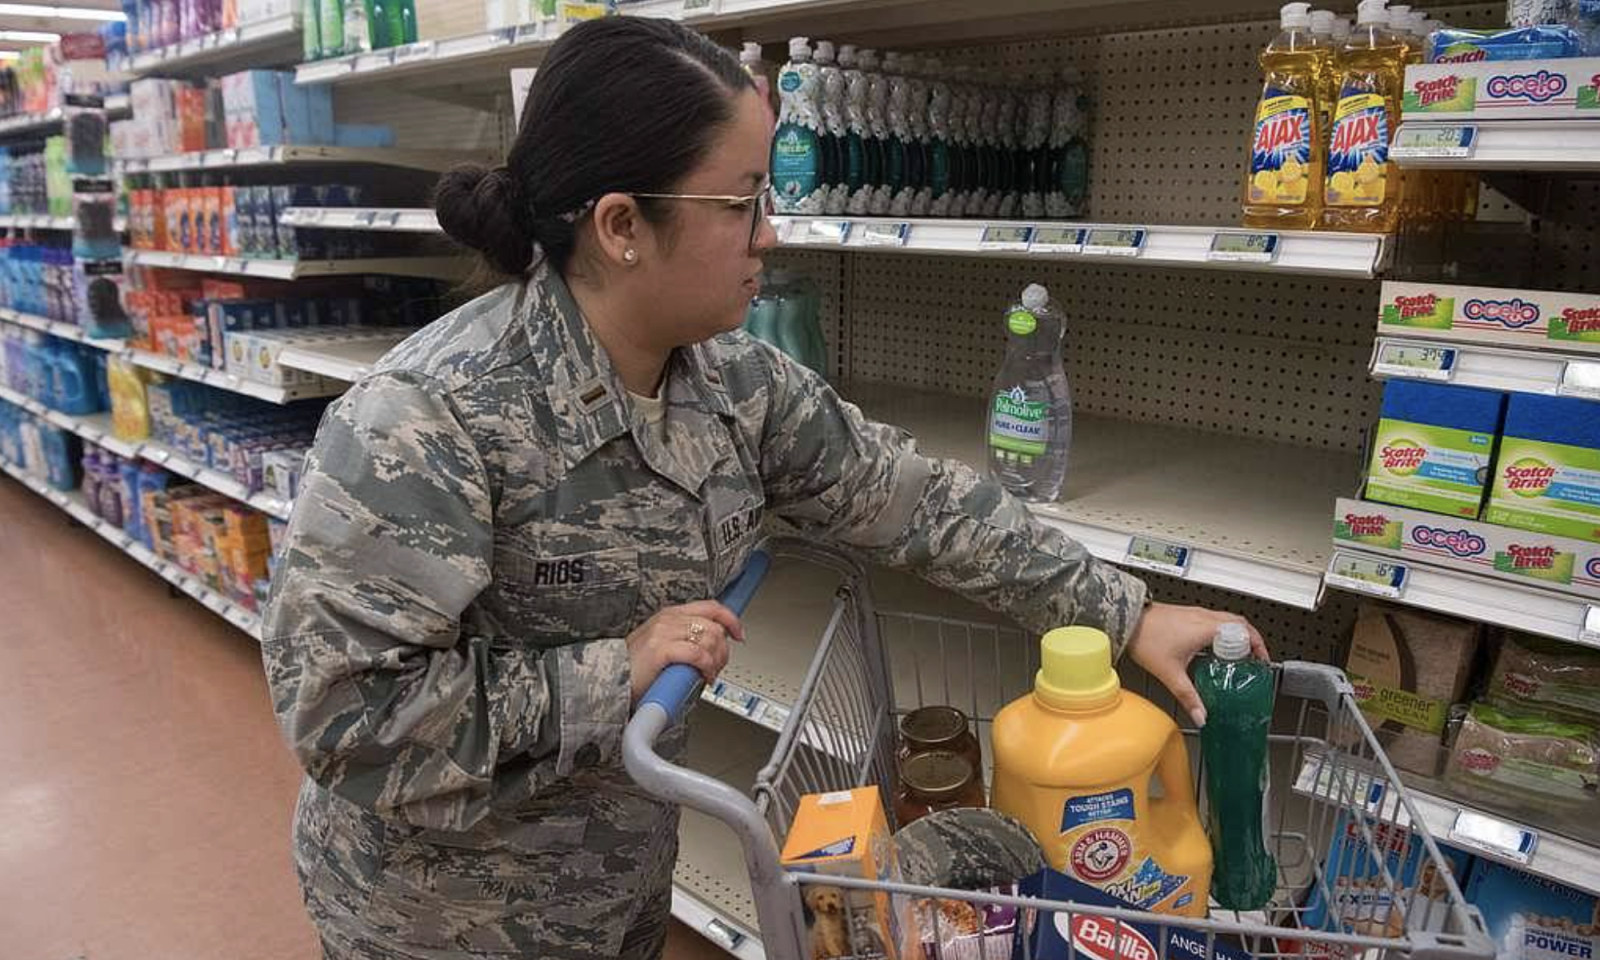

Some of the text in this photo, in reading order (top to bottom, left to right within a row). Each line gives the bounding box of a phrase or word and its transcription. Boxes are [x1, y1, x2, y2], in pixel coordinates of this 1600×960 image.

[1256, 116, 1303, 154] AJAX
[1332, 115, 1379, 155] AJAX
[996, 397, 1041, 419] Palmolive
[1508, 477, 1549, 489] Brite
[722, 516, 743, 546] U.S.
[535, 560, 583, 585] RIOS
[1380, 688, 1434, 712] greener
[1069, 796, 1128, 813] TOUGH STAINS
[1170, 933, 1206, 958] ANGE
[1524, 934, 1593, 959] POWER
